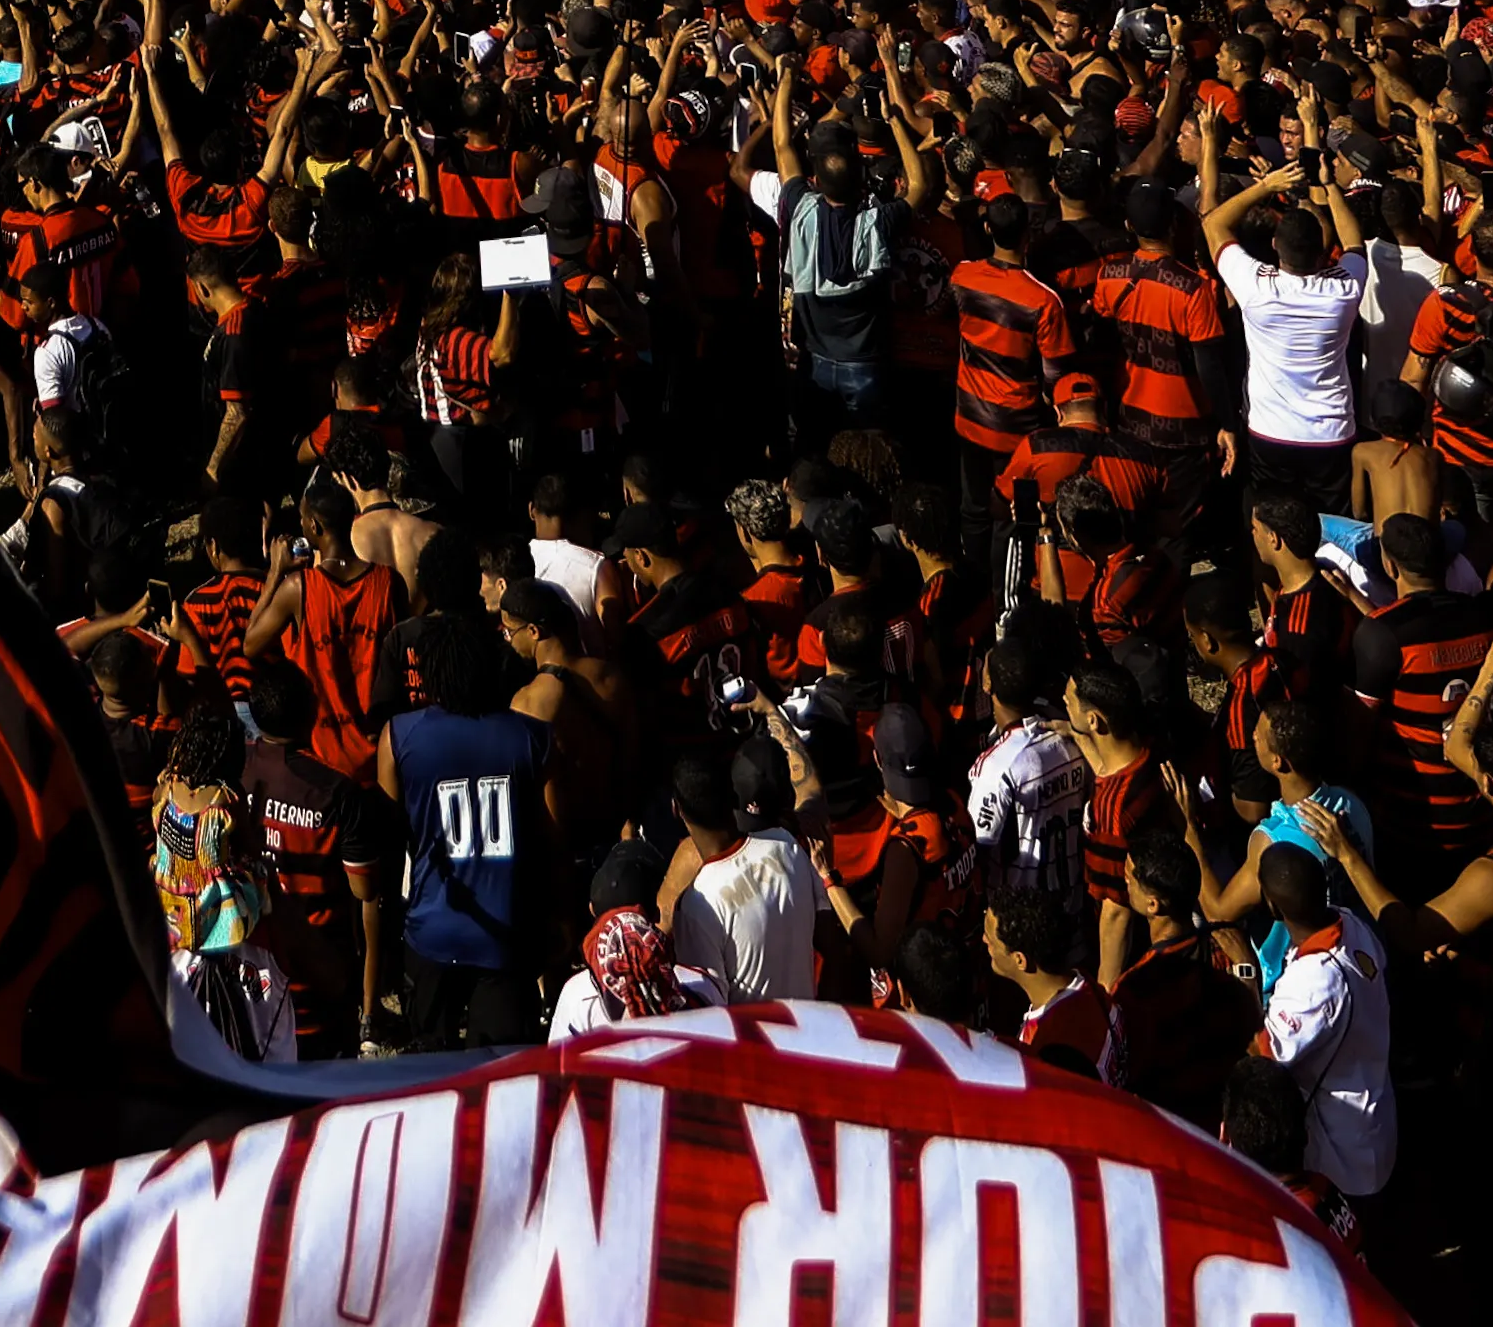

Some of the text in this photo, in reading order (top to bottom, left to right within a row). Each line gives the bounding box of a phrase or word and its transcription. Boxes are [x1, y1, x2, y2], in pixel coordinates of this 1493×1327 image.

[264, 799, 322, 830] ETERNAS
[437, 774, 516, 860] 00
[943, 843, 977, 892] TROP
